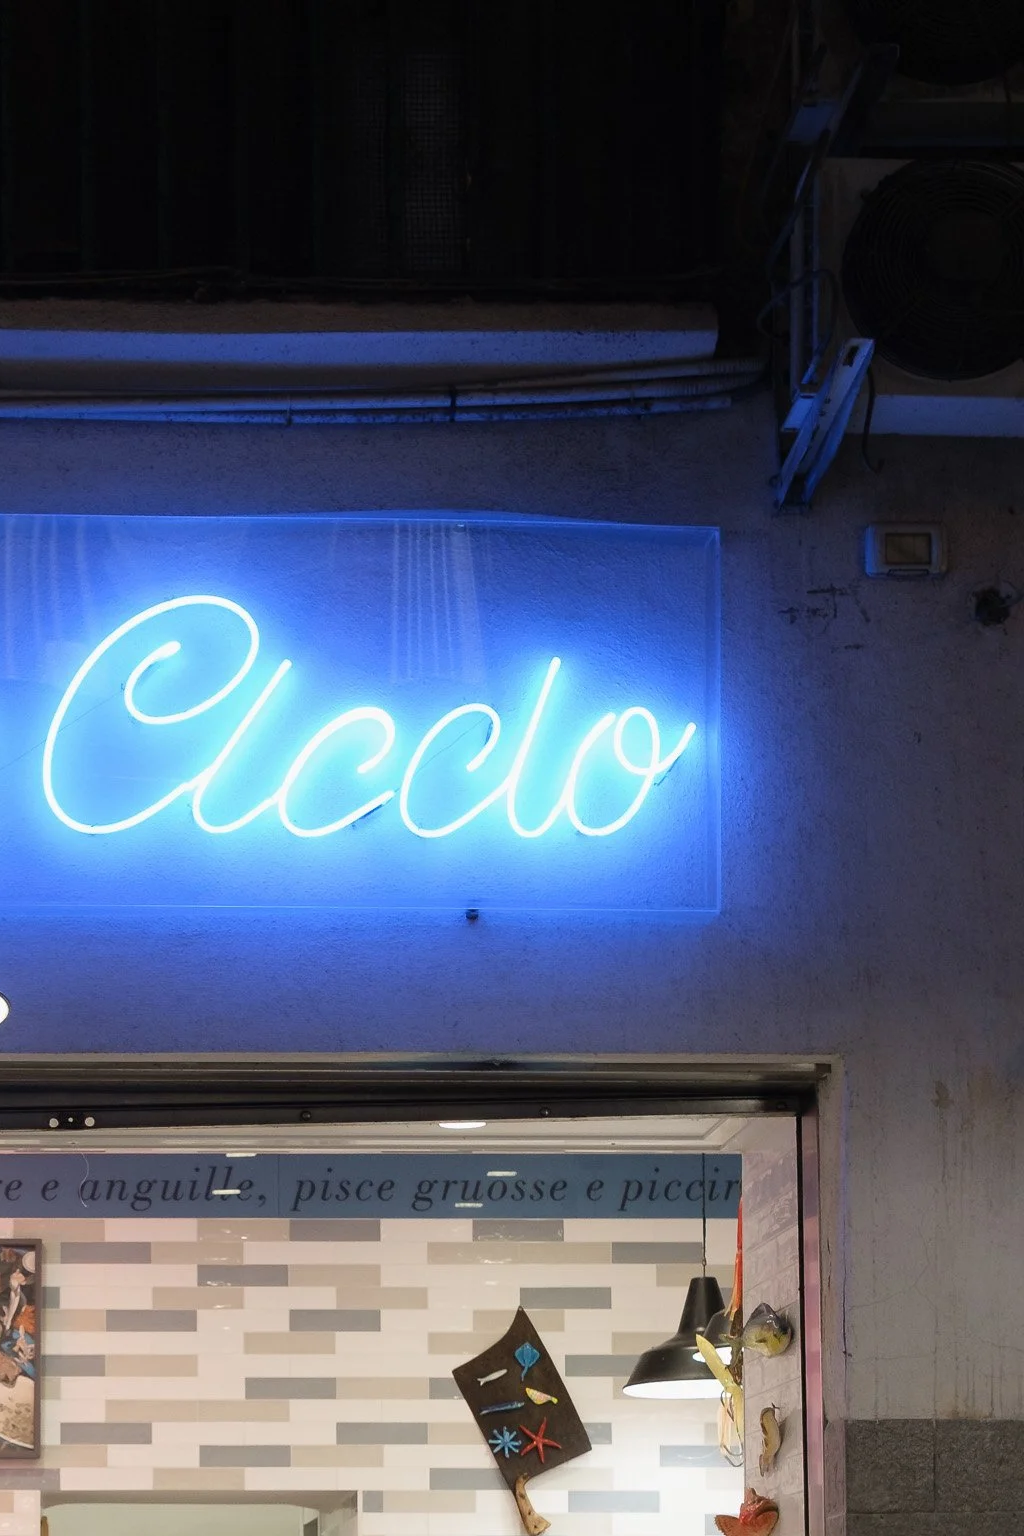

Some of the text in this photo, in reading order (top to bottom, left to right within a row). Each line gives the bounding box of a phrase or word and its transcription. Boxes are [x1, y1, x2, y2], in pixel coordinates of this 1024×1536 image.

[41, 1176, 59, 1202] e
[78, 1165, 269, 1212] anguille,
[289, 1167, 395, 1212] pisce
[412, 1176, 569, 1212] gruosse
[586, 1176, 605, 1202] e
